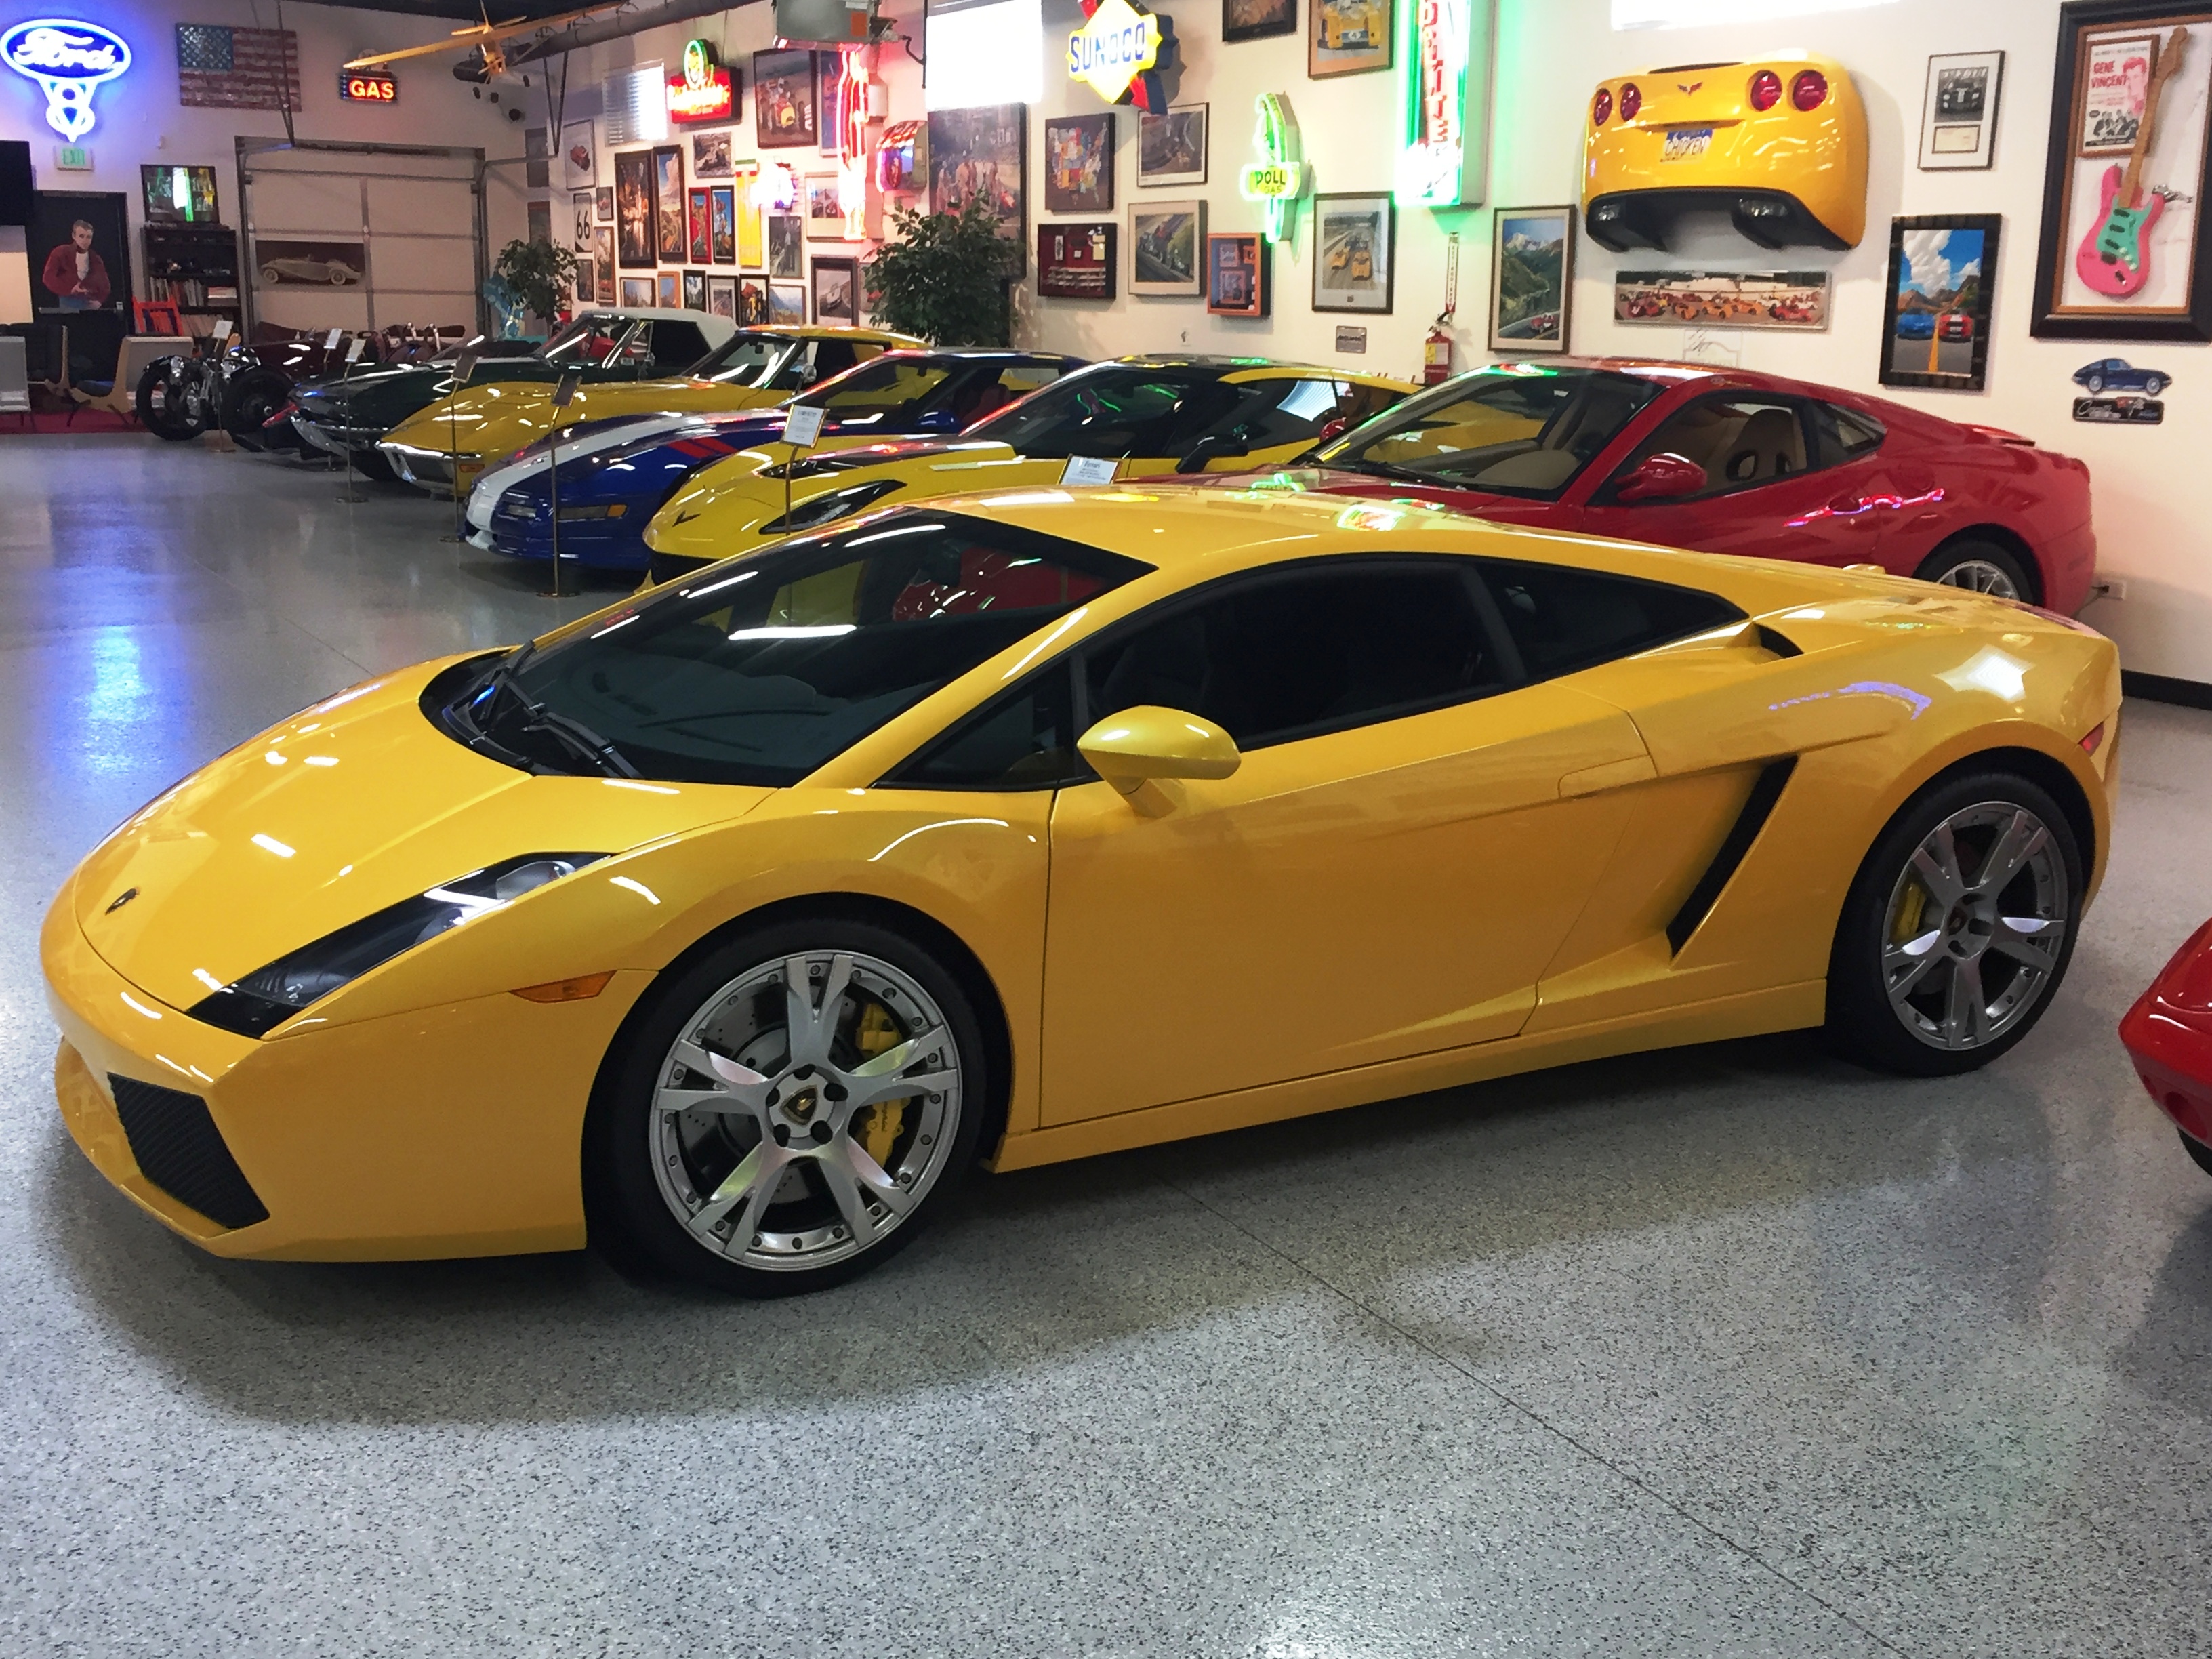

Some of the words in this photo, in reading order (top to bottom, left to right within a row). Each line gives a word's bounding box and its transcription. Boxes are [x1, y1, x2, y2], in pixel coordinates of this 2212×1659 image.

[13, 28, 116, 70] Ford
[1070, 22, 1145, 73] SUNOCO
[2093, 61, 2115, 74] GENE
[348, 79, 394, 99] GAS
[2091, 75, 2129, 89] VINCENT
[1264, 186, 1282, 194] GAS
[576, 209, 591, 240] 66
